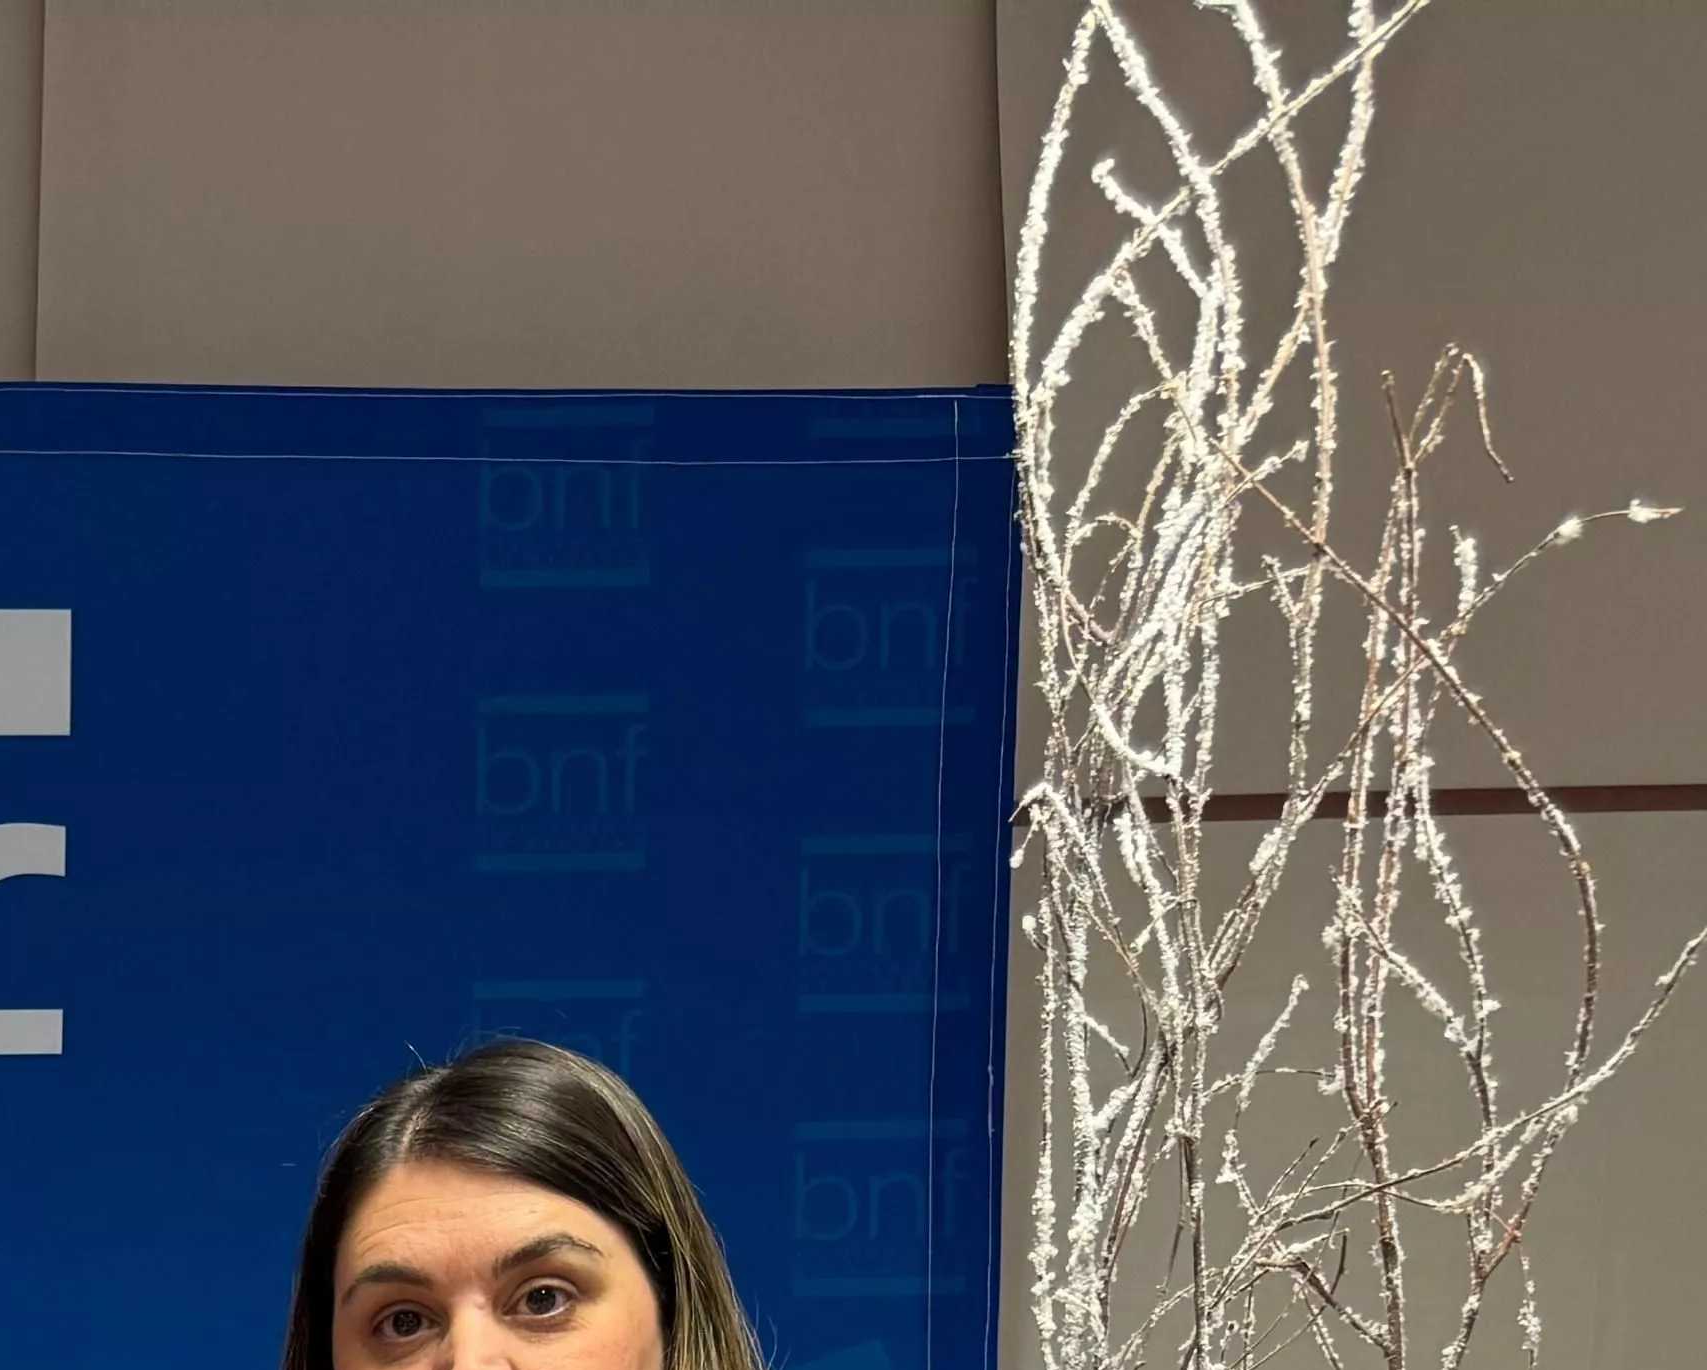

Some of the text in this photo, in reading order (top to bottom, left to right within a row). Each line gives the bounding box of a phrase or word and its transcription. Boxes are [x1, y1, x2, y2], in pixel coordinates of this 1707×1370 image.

[478, 438, 647, 531] bnf
[804, 581, 974, 671] bnf
[476, 723, 647, 815] bnf
[798, 866, 970, 957] bnf
